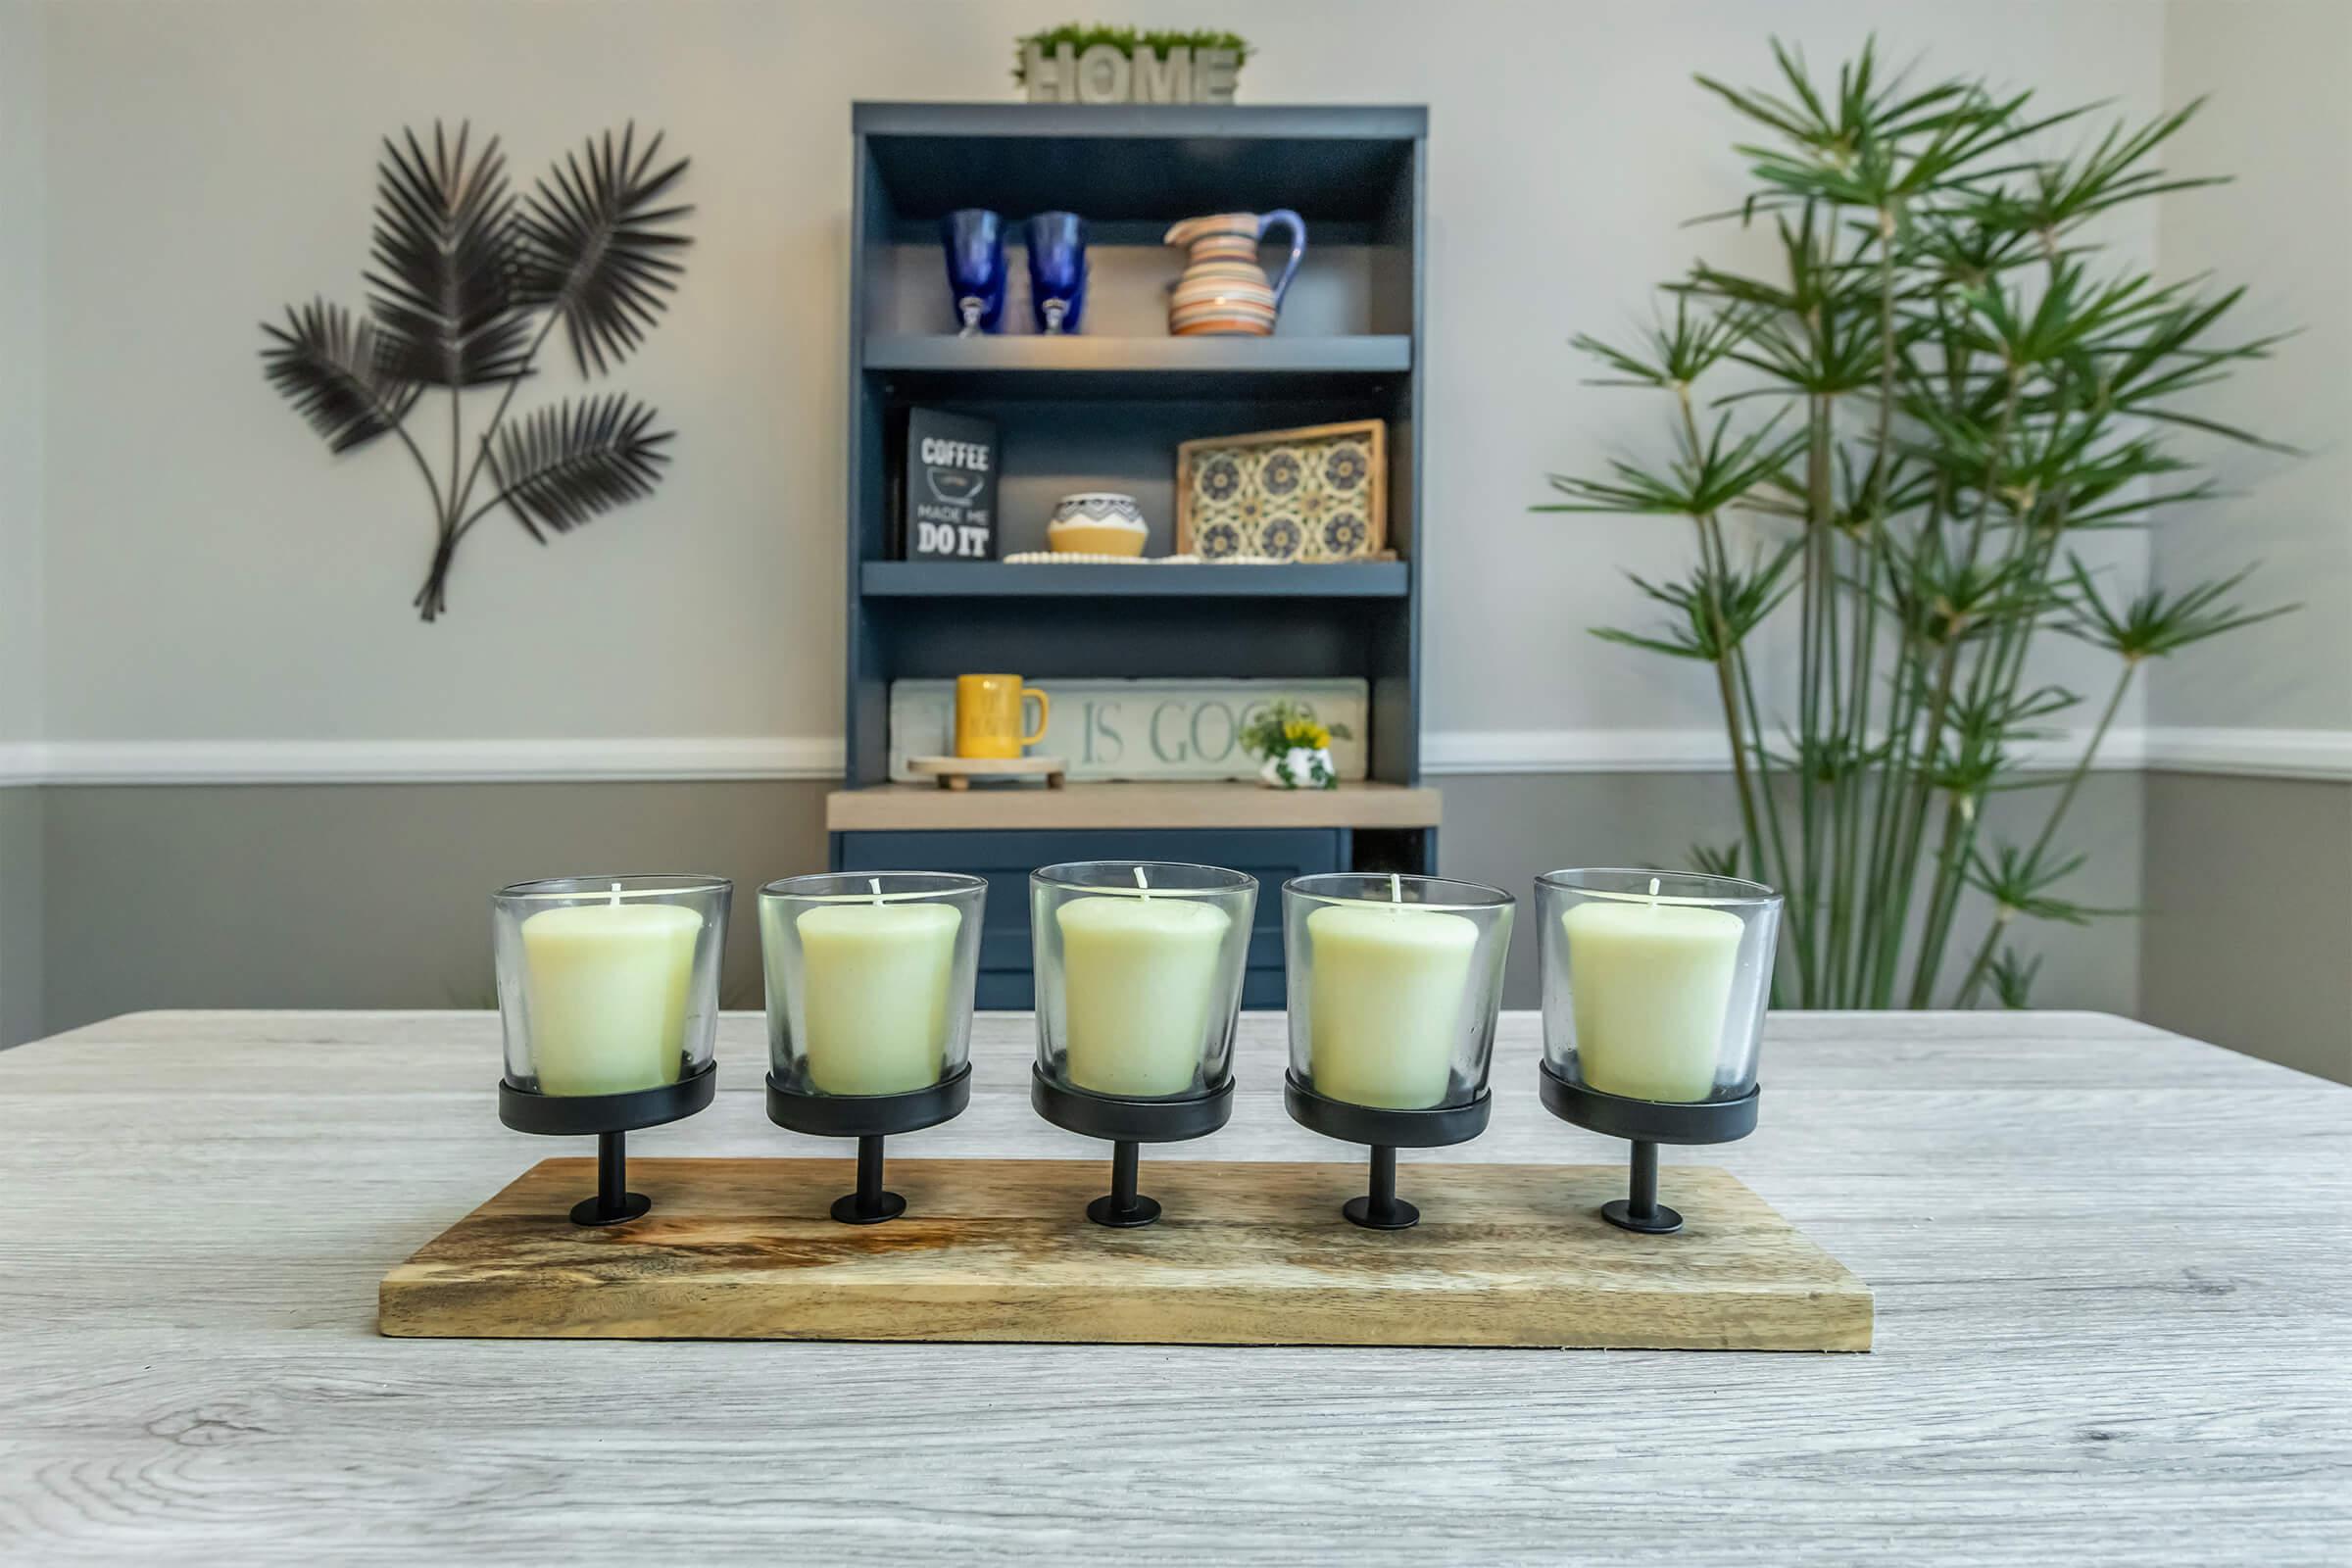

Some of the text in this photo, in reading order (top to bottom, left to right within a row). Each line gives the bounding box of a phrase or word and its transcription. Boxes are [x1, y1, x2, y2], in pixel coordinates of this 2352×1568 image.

[1027, 41, 1240, 104] HOME
[921, 438, 990, 471] COFFEE
[918, 522, 989, 557] DO IT
[1082, 700, 1125, 764] IS
